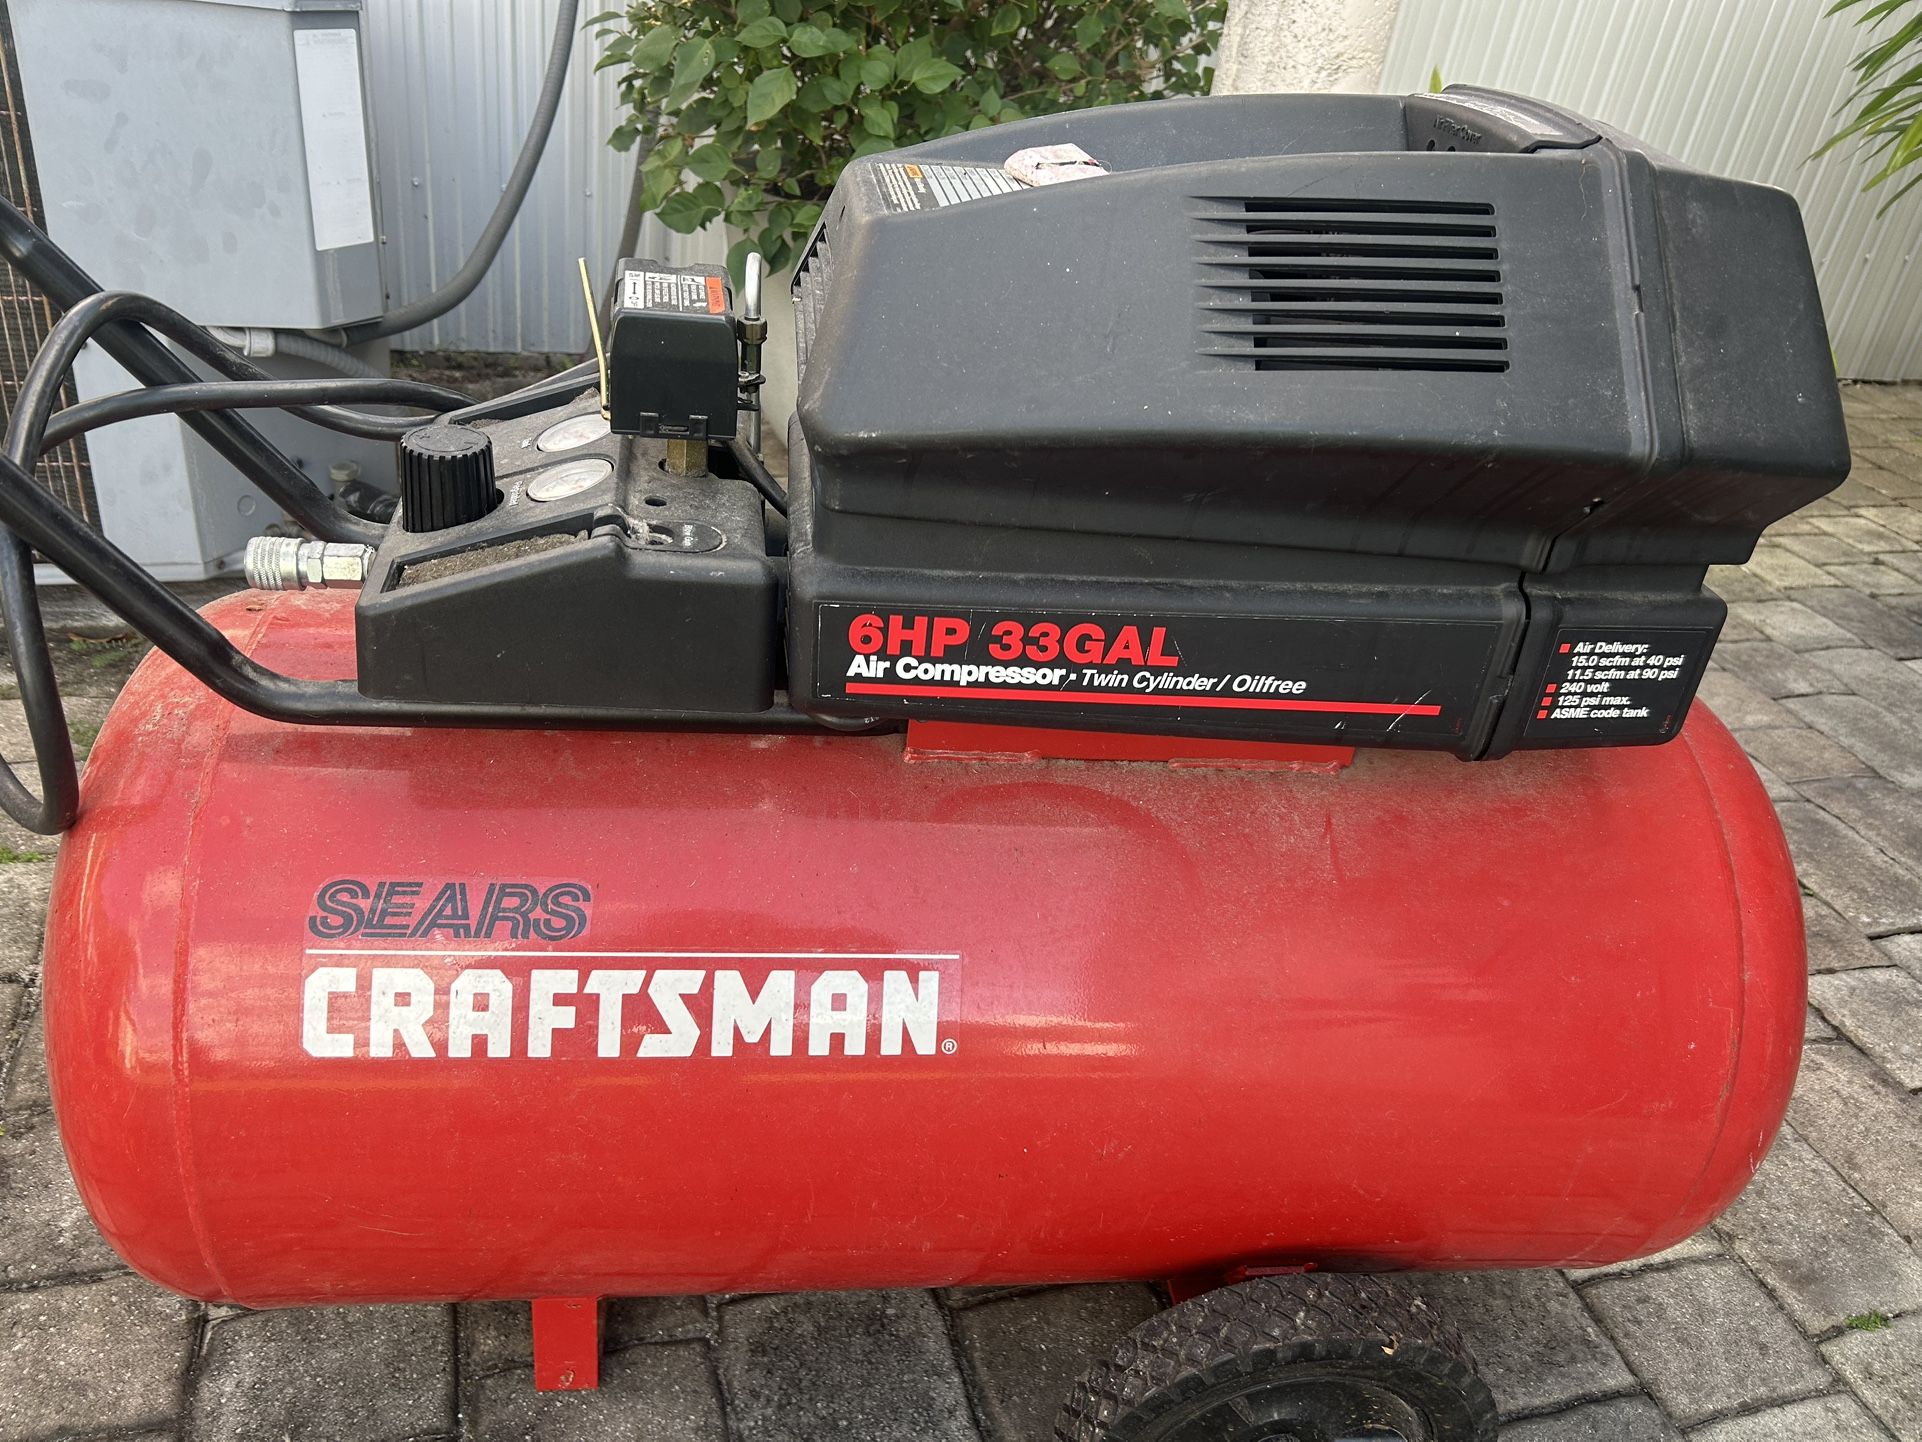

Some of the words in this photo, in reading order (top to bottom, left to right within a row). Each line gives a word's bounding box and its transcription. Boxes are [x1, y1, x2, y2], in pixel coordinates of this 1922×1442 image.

[848, 613, 971, 657] 6HP
[988, 620, 1180, 667] 33GAL
[1572, 641, 1595, 654] Air
[1594, 641, 1650, 655] Delivery:
[1571, 655, 1599, 667] 15.0
[1598, 655, 1631, 667] scfm
[1630, 655, 1647, 667] at
[1645, 655, 1664, 666] 40
[1662, 654, 1685, 668] psi
[846, 654, 891, 678] Air
[895, 656, 1067, 688] Compressor
[1081, 668, 1129, 688] Twin
[1231, 674, 1308, 695] Oilfree
[1566, 668, 1593, 680] 11.5
[1593, 668, 1626, 680] scfm
[1625, 668, 1642, 680] at
[1640, 668, 1659, 679] 90
[1657, 667, 1680, 681] psi
[1559, 681, 1586, 694] 240
[1586, 681, 1610, 693] volt
[1556, 695, 1581, 706] 125
[1580, 694, 1602, 708] psi
[1600, 695, 1631, 706] max.
[1550, 706, 1591, 719] ASME
[1589, 706, 1621, 719] code
[1621, 706, 1650, 718] tank
[309, 878, 592, 942] SEARS
[301, 966, 940, 1059] CRAFTSMAN
